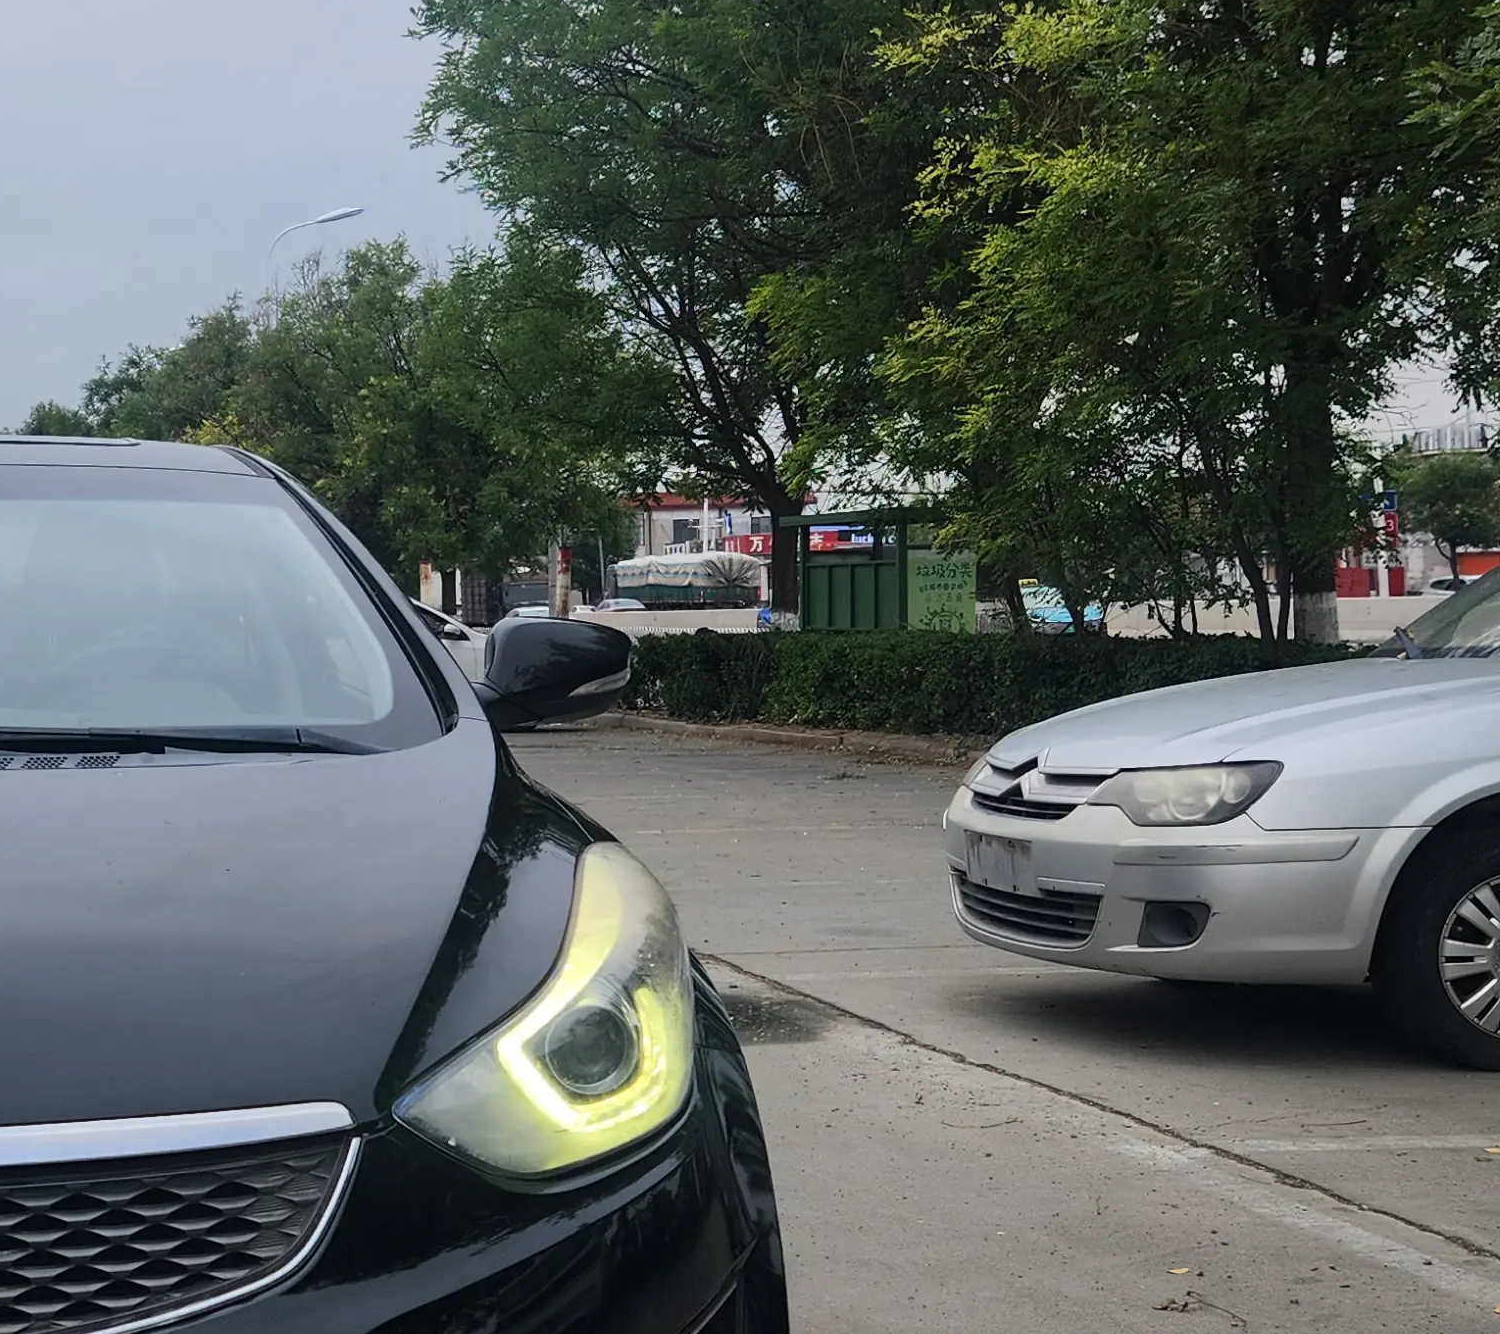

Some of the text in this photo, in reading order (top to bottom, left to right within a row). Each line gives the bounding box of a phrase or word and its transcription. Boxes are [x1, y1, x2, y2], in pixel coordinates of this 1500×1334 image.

[851, 533, 886, 544] luck
[916, 562, 973, 579] 垃圾分类
